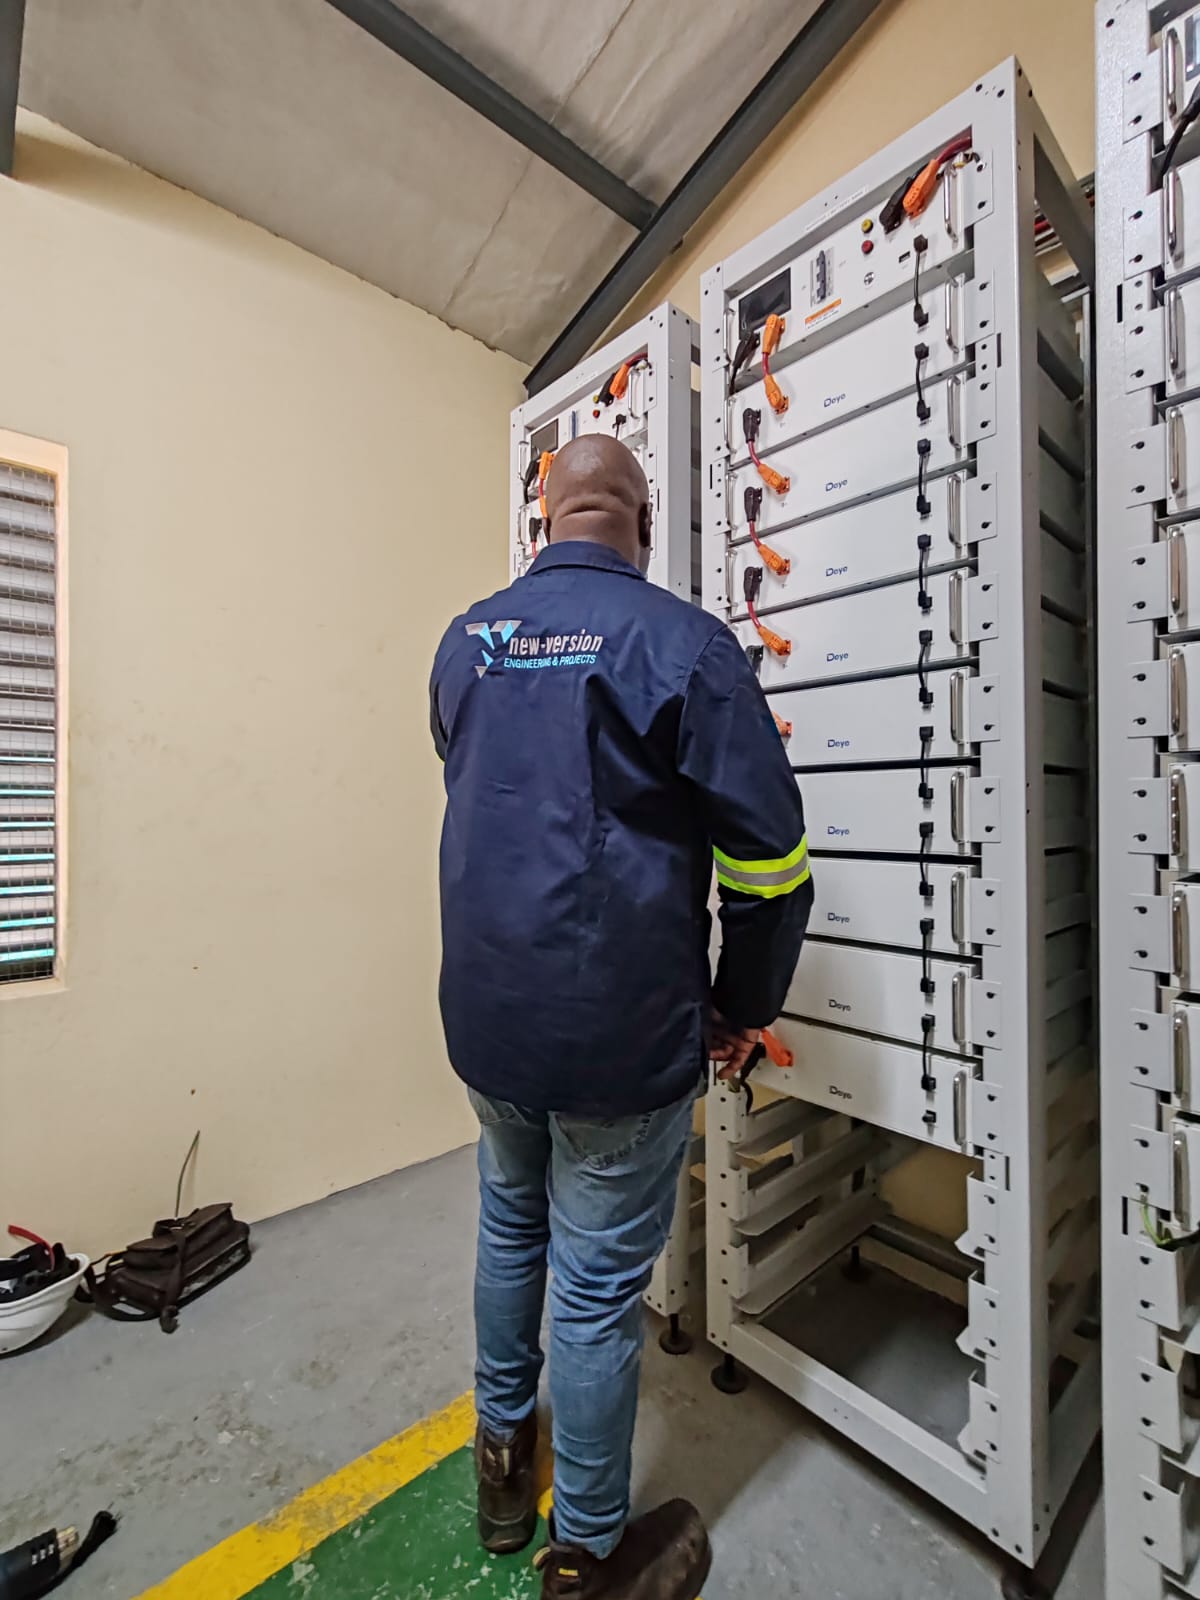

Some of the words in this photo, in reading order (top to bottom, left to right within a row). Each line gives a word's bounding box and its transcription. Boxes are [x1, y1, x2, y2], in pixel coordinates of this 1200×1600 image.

[509, 628, 604, 655] new-version
[504, 656, 551, 668] ENGINEERING
[551, 656, 559, 666] &
[559, 654, 596, 666] PROJECTS
